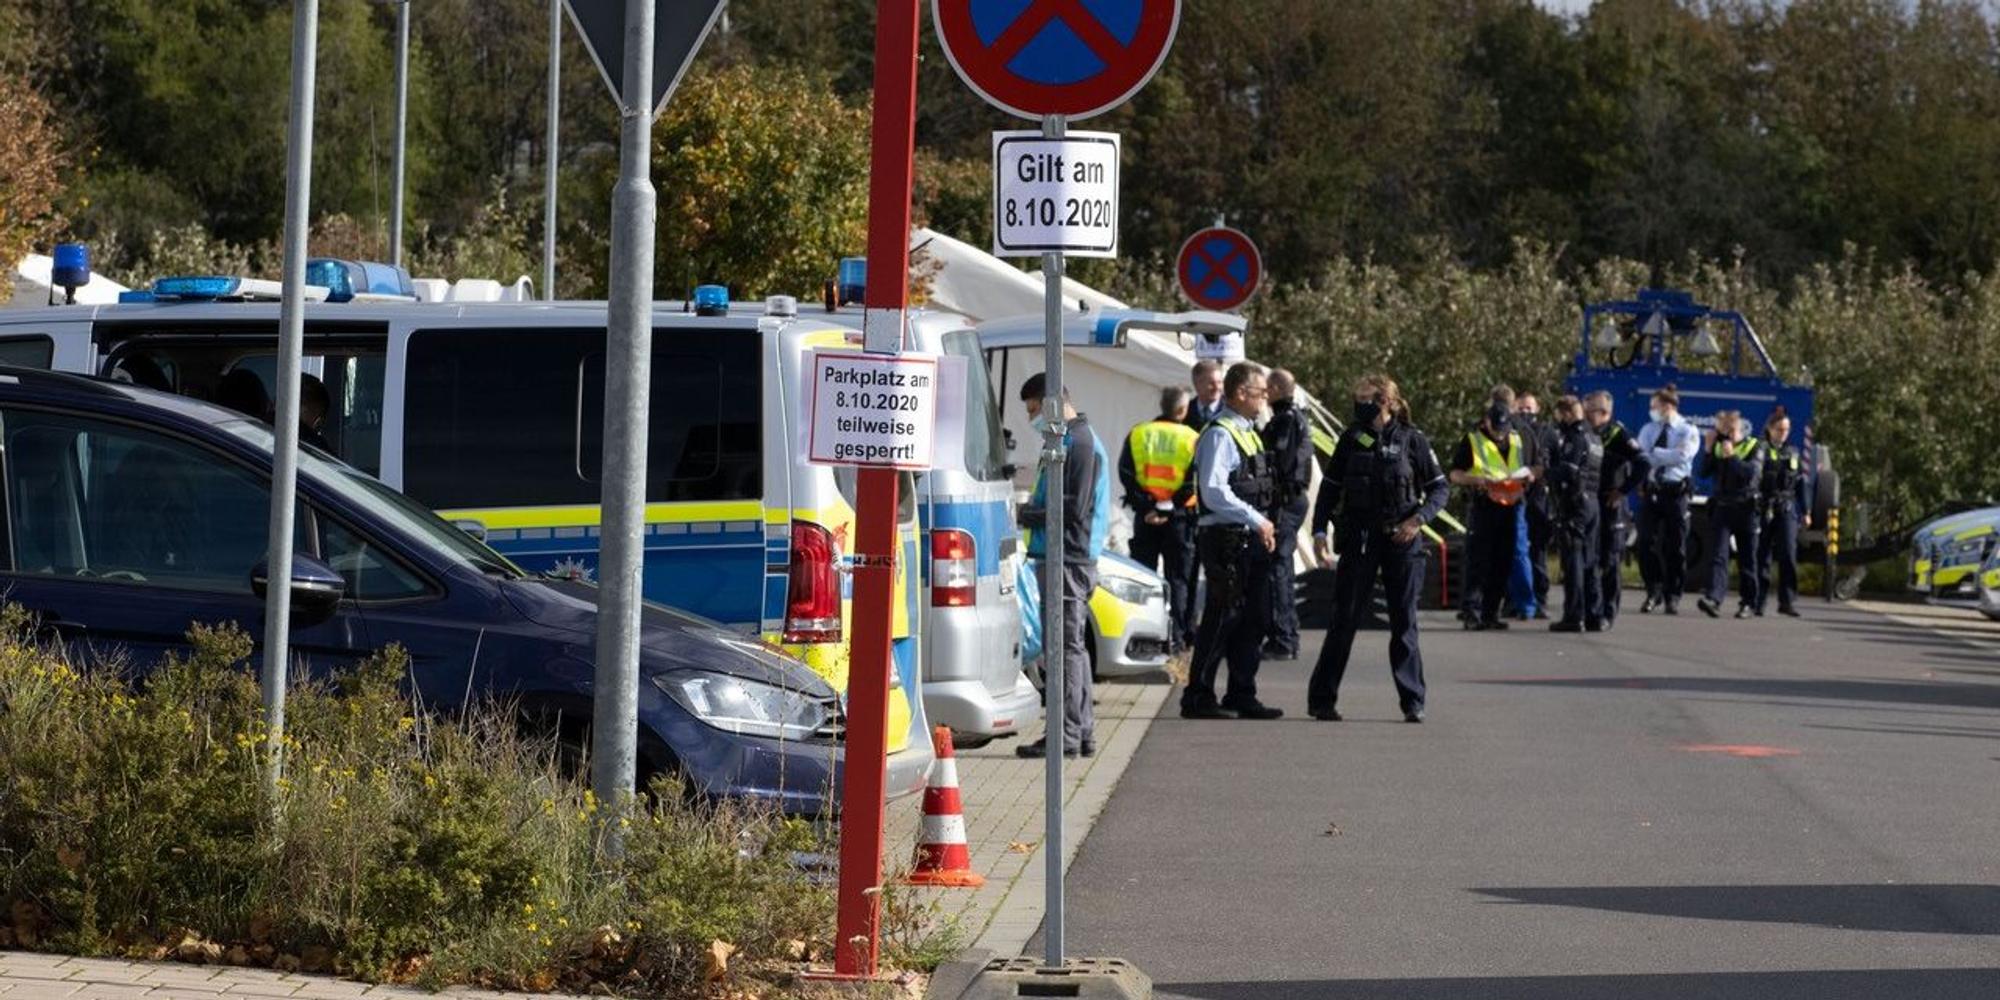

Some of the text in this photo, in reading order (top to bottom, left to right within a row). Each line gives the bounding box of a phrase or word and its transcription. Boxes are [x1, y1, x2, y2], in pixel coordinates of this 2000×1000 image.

[1017, 153, 1104, 184] Gilt am
[1005, 197, 1111, 228] 8.10.2020
[824, 366, 930, 388] Parkplatz am
[835, 390, 919, 412] 8.10.2020
[837, 416, 915, 436] teilweise
[834, 442, 915, 460] gesperrt!
